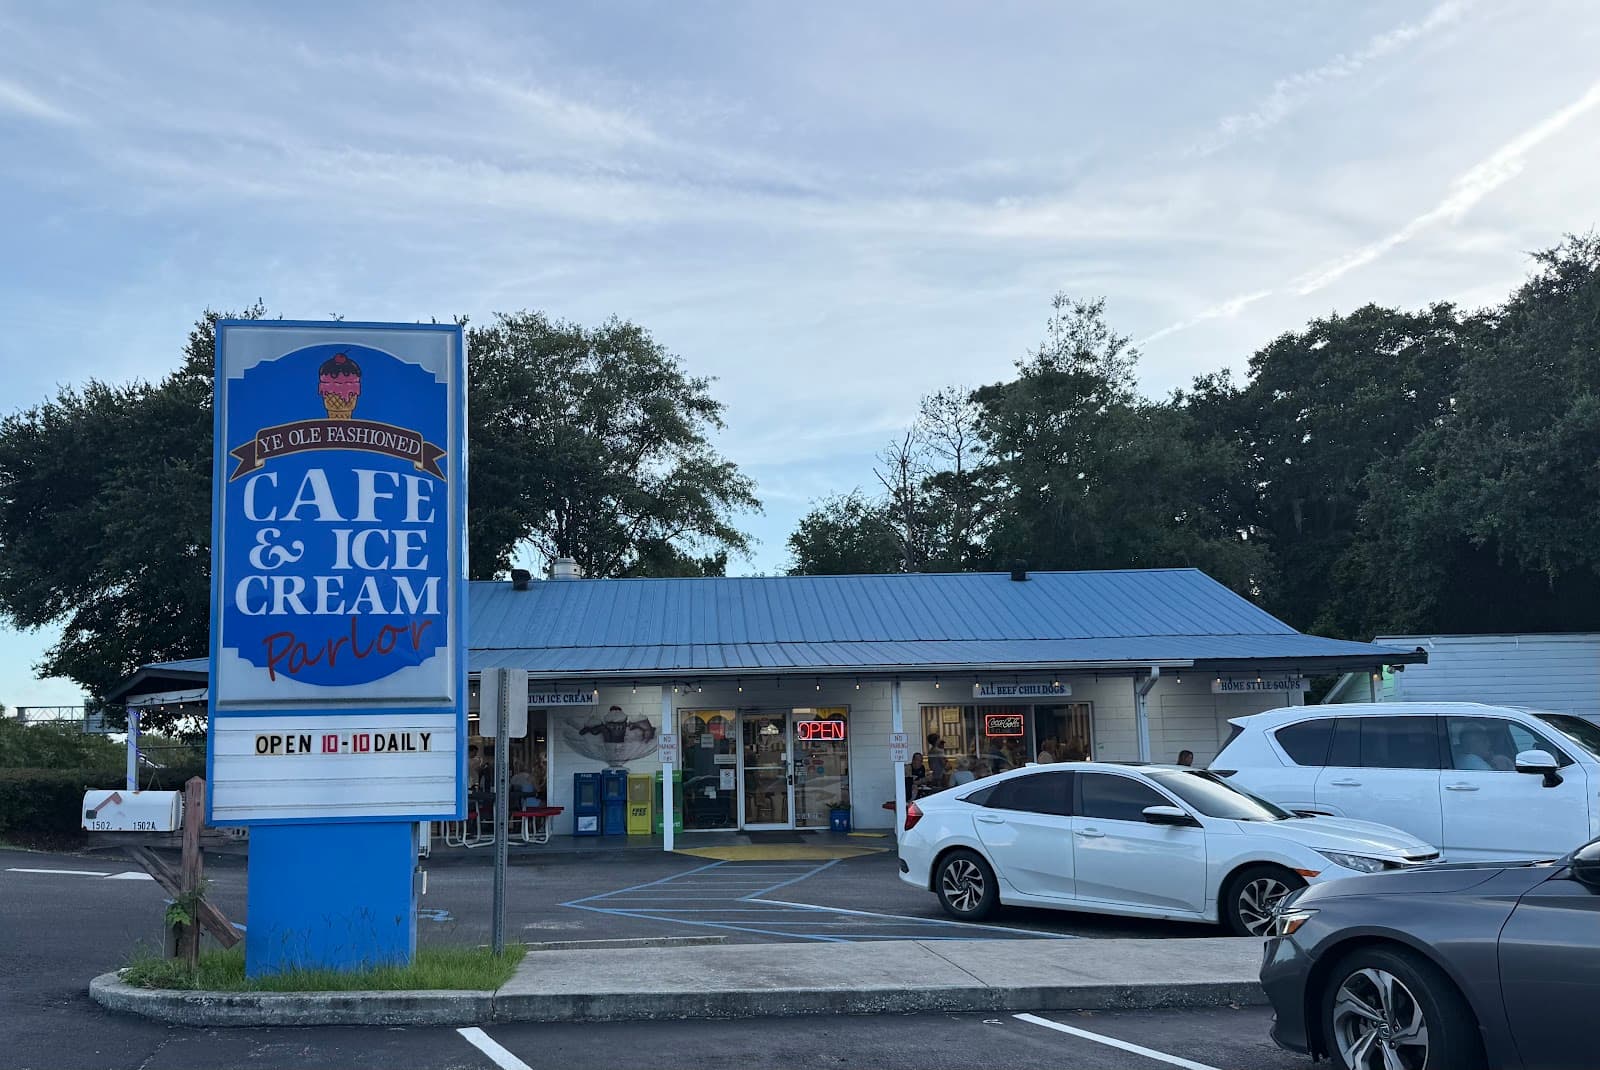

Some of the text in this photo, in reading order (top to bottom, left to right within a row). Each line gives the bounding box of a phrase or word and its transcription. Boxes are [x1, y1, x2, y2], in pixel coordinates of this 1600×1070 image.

[259, 426, 421, 456] YE OLE FASHIONED
[243, 468, 435, 523] CAFE
[249, 527, 428, 571] & ICE
[235, 575, 441, 616] CREAM
[262, 616, 433, 682] Parlor
[980, 685, 1065, 696] ALL BEEF CHILI DOGS
[1221, 680, 1301, 690] HOME STYLE SOUPS
[547, 694, 561, 703] ICE
[563, 694, 593, 703] CREAM
[799, 722, 844, 740] OPEN
[256, 735, 312, 754] OPEN
[133, 821, 156, 830] 1502A
